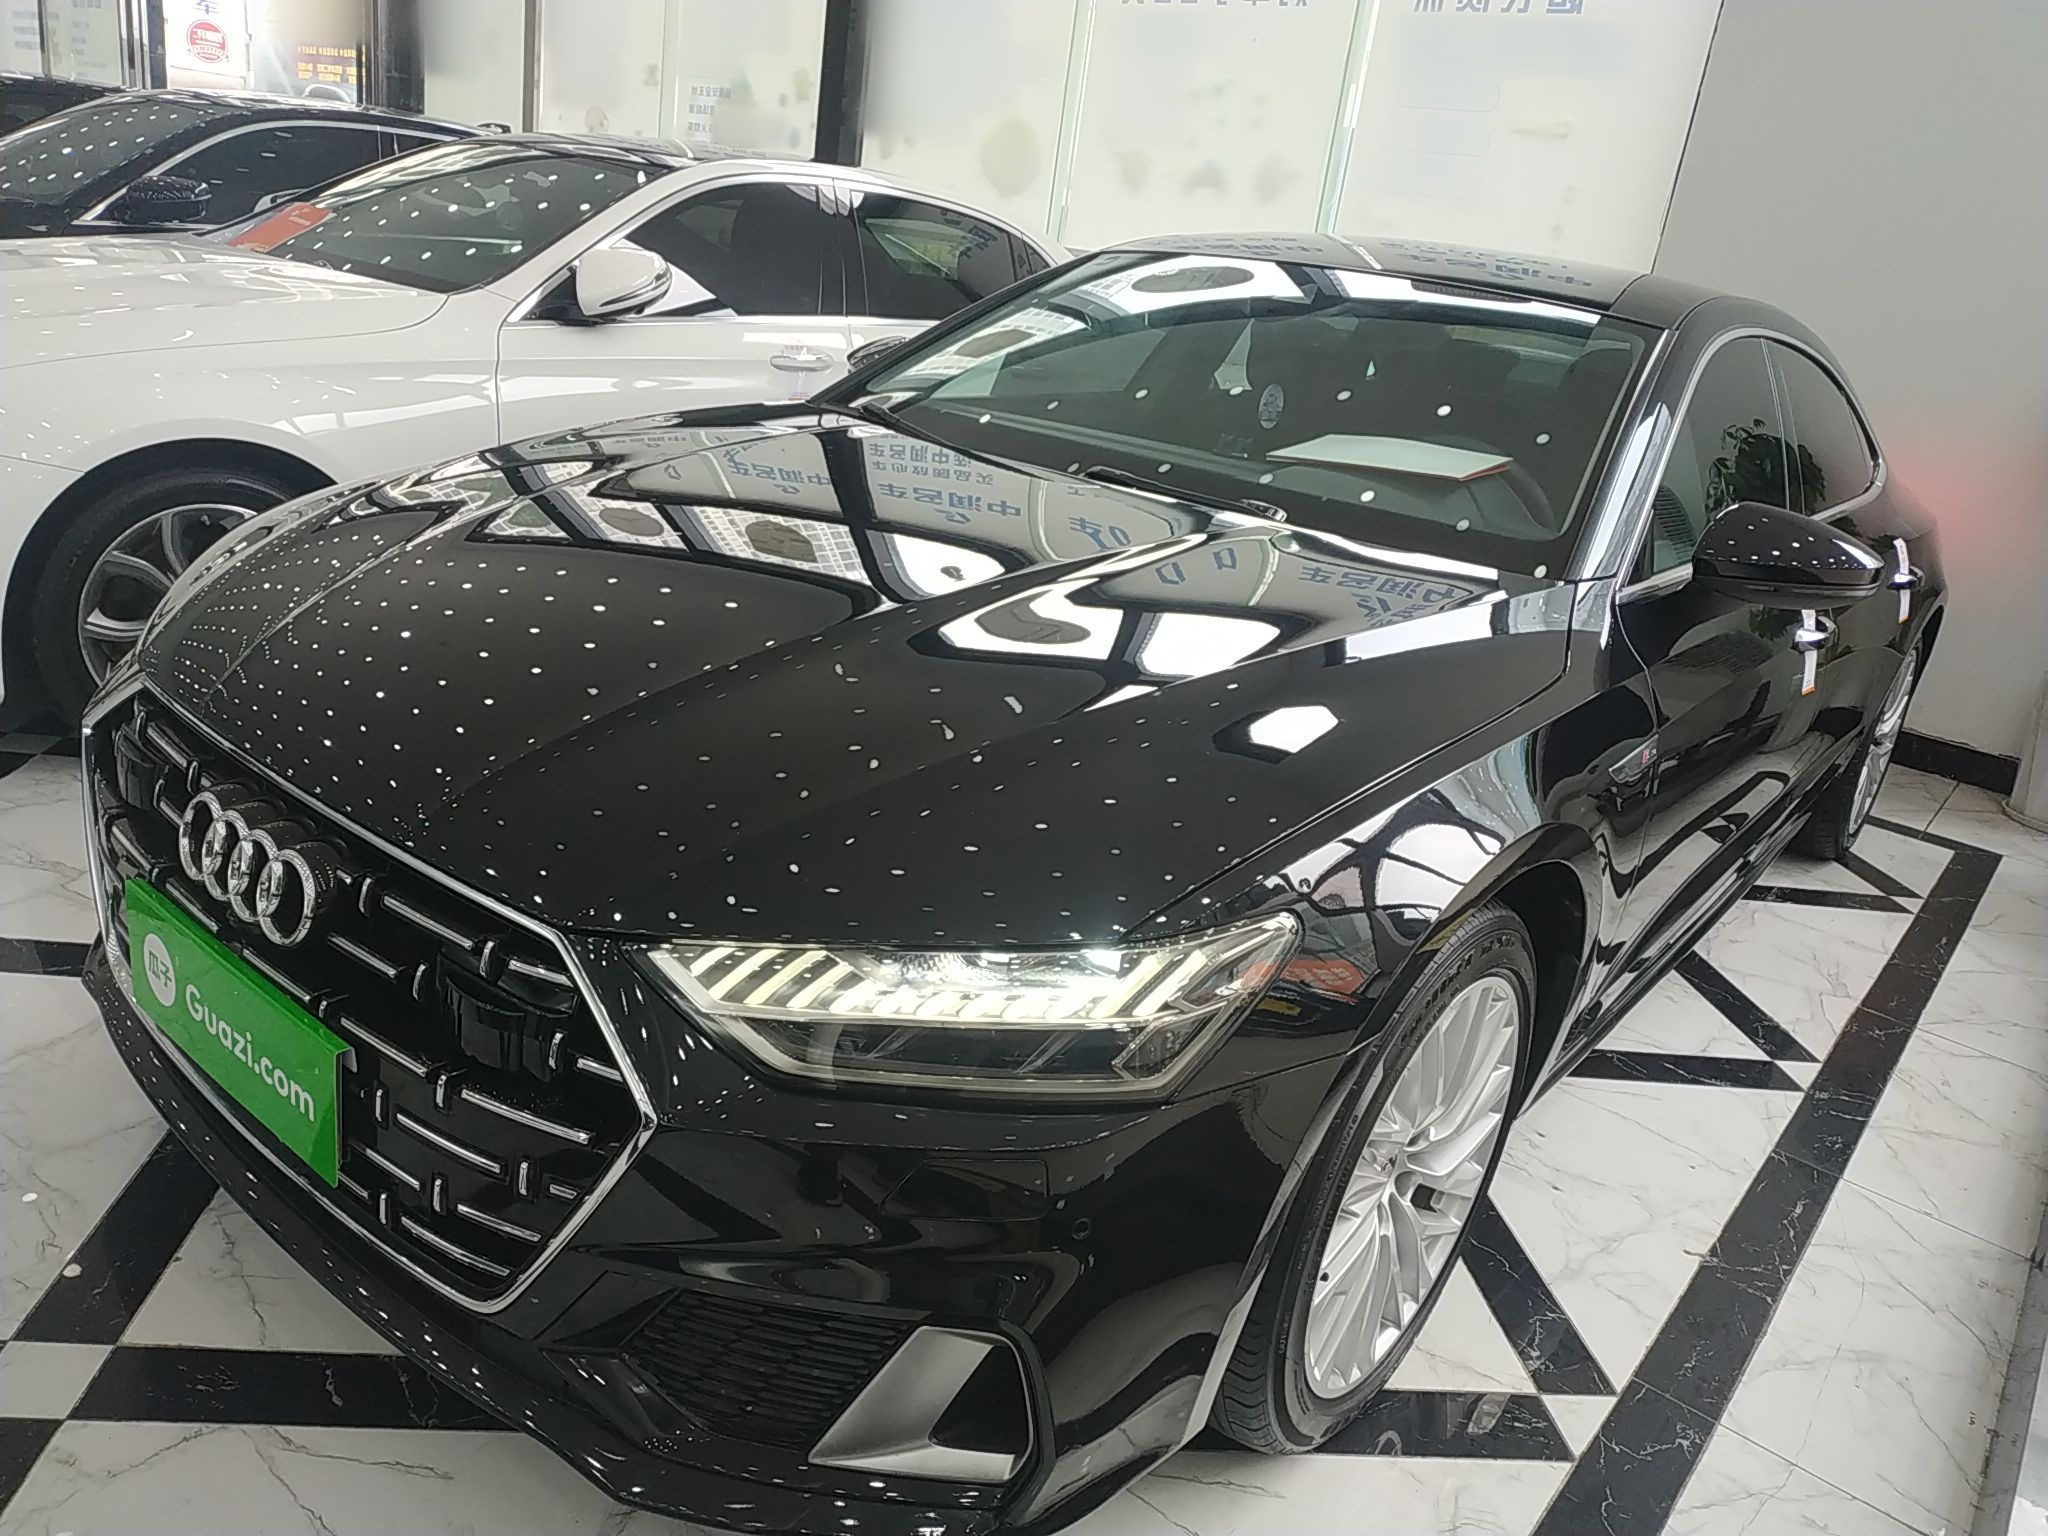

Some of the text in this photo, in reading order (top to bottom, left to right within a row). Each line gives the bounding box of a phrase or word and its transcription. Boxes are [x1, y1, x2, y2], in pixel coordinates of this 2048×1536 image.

[878, 483, 1021, 517] 中润名车
[185, 983, 316, 1123] Guazi.com
